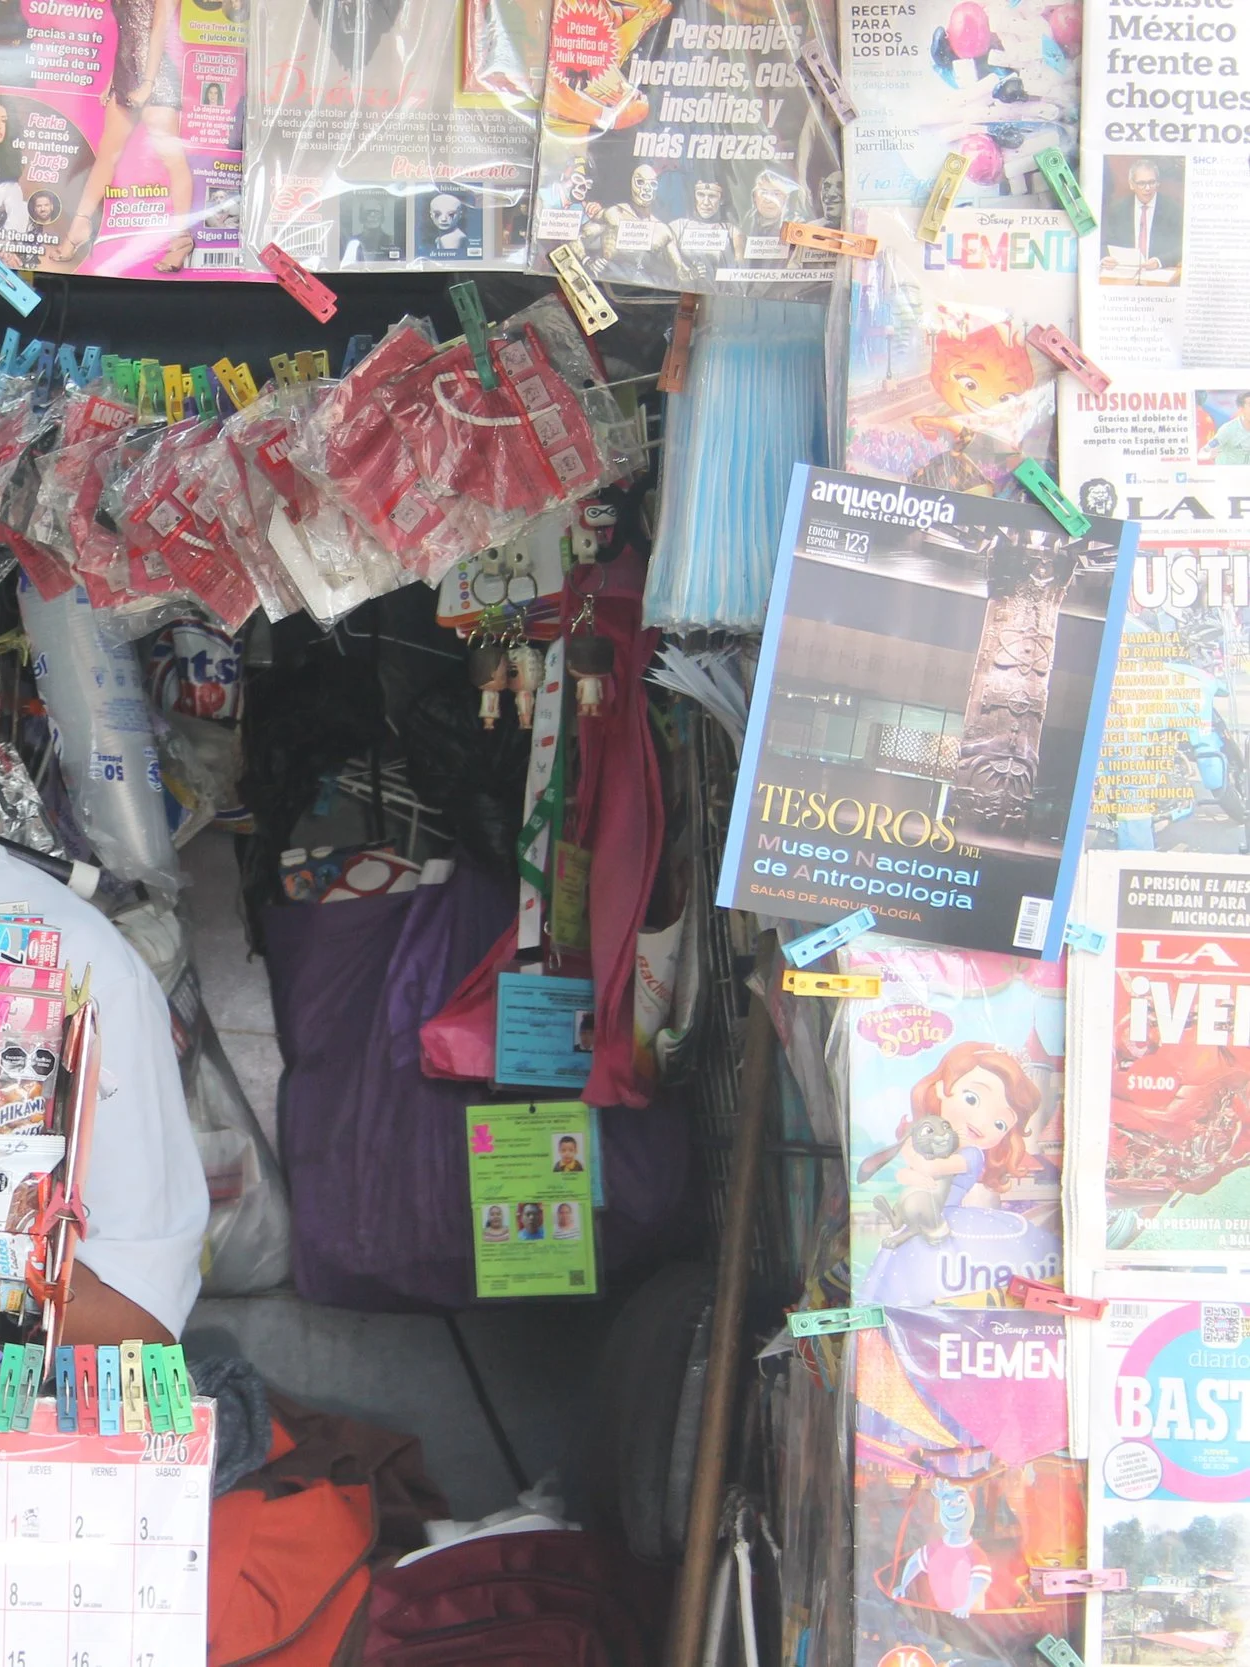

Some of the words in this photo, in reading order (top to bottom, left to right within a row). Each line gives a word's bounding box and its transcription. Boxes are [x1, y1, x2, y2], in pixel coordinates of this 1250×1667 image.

[29, 1, 104, 20] sobrevive
[851, 4, 916, 16] RECETAS
[26, 26, 66, 40] gracias
[68, 30, 74, 39] a
[76, 30, 90, 40] su
[92, 30, 103, 42] fe
[566, 21, 596, 37] ¡Póster
[852, 19, 891, 30] PARA
[1109, 15, 1236, 42] México
[554, 37, 596, 50] biográfico
[598, 40, 608, 51] de
[667, 19, 801, 50] Personajes
[852, 32, 902, 43] TODOS
[30, 41, 43, 51] en
[45, 42, 89, 56] vírgenes
[90, 48, 98, 59] y
[556, 51, 576, 64] Hulk
[579, 53, 605, 66] Hogan!
[852, 45, 879, 57] LOS
[882, 42, 919, 56] DÍAS
[25, 54, 35, 64] la
[38, 56, 68, 69] ayuda
[71, 60, 85, 69] de
[87, 61, 100, 71] un
[1107, 49, 1212, 75] frente
[1218, 56, 1238, 75] a
[30, 69, 93, 85] numerólogo
[628, 54, 749, 90] increíbles,
[659, 92, 762, 125] insólitas
[767, 98, 783, 128] y
[1106, 85, 1250, 117] choques
[1105, 120, 1250, 144] externos
[634, 129, 684, 157] más
[687, 133, 794, 160] rarezas...
[1021, 216, 1059, 225] PIXAR
[1077, 392, 1187, 411] ILUSIONAN
[1132, 414, 1140, 422] al
[1142, 414, 1175, 422] doblete
[1177, 414, 1188, 422] de
[1131, 426, 1156, 434] Mora,
[1160, 447, 1175, 455] Sub
[1178, 447, 1189, 455] 20
[811, 479, 955, 529] arqueología
[1127, 497, 1215, 520] LA
[849, 507, 916, 528] mexicana
[808, 525, 839, 539] EDICIÓN
[807, 536, 838, 549] ESPECIAL
[843, 532, 870, 554] 123
[106, 765, 123, 781] 50
[758, 783, 956, 854] TESOROS
[959, 845, 982, 859] DEL
[757, 833, 849, 866] Museo
[856, 848, 979, 887] Nacional
[753, 858, 787, 878] de
[794, 864, 974, 910] Antropología
[1131, 876, 1141, 889] A
[1143, 875, 1201, 890] PRISIÓN
[1205, 879, 1221, 891] EL
[1128, 893, 1206, 908] OPERABAN
[1210, 895, 1246, 909] PARA
[1141, 941, 1238, 966] LA
[877, 1016, 945, 1057] Sofía
[1128, 1076, 1175, 1091] $10.00
[940, 1254, 1011, 1291] Una
[1110, 1320, 1134, 1329] $7.00
[1189, 1350, 1250, 1369] diario
[141, 1431, 188, 1463] 2026
[28, 1465, 51, 1475] JUEVES
[91, 1467, 118, 1477] VIERNES
[155, 1467, 180, 1477] SÁBADO
[75, 1517, 83, 1538] 2
[140, 1518, 148, 1540] 3
[10, 1583, 19, 1606] 8
[73, 1584, 82, 1606] 9
[138, 1587, 155, 1609] 10
